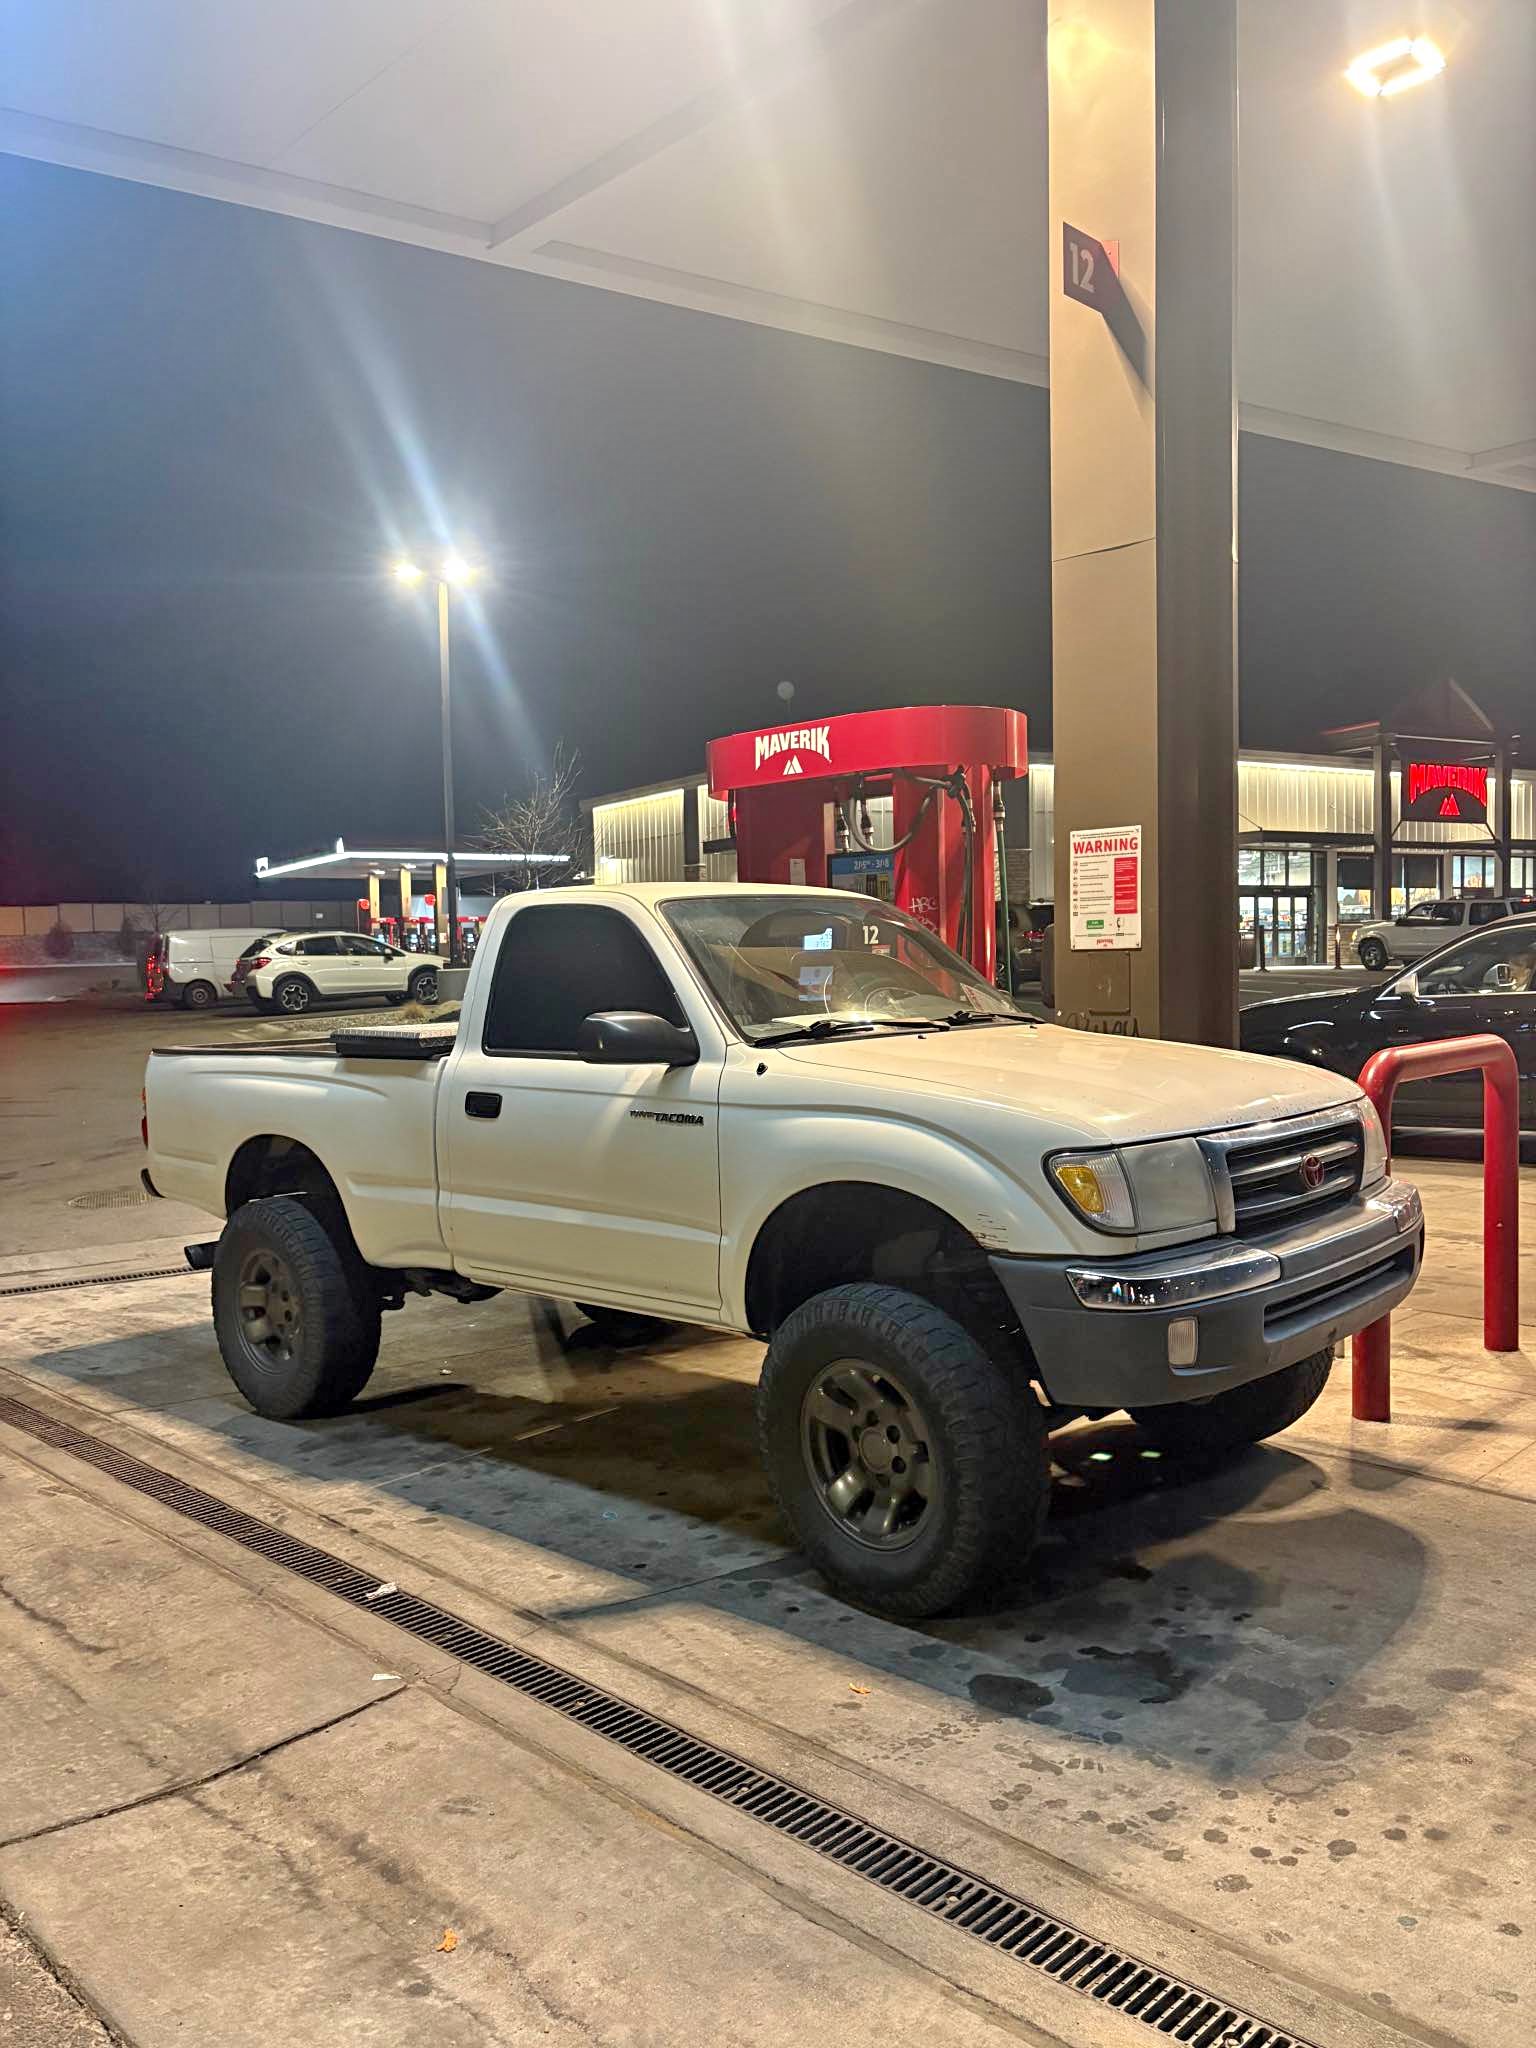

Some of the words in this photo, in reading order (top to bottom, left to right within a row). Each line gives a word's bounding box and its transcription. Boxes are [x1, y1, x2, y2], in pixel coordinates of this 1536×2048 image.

[1069, 241, 1095, 294] 12
[755, 726, 831, 771] MAVERIK
[1409, 763, 1488, 807] MAVERIK
[1073, 837, 1138, 855] WARNING
[862, 925, 879, 945] 12
[653, 1112, 704, 1126] TACOMA
